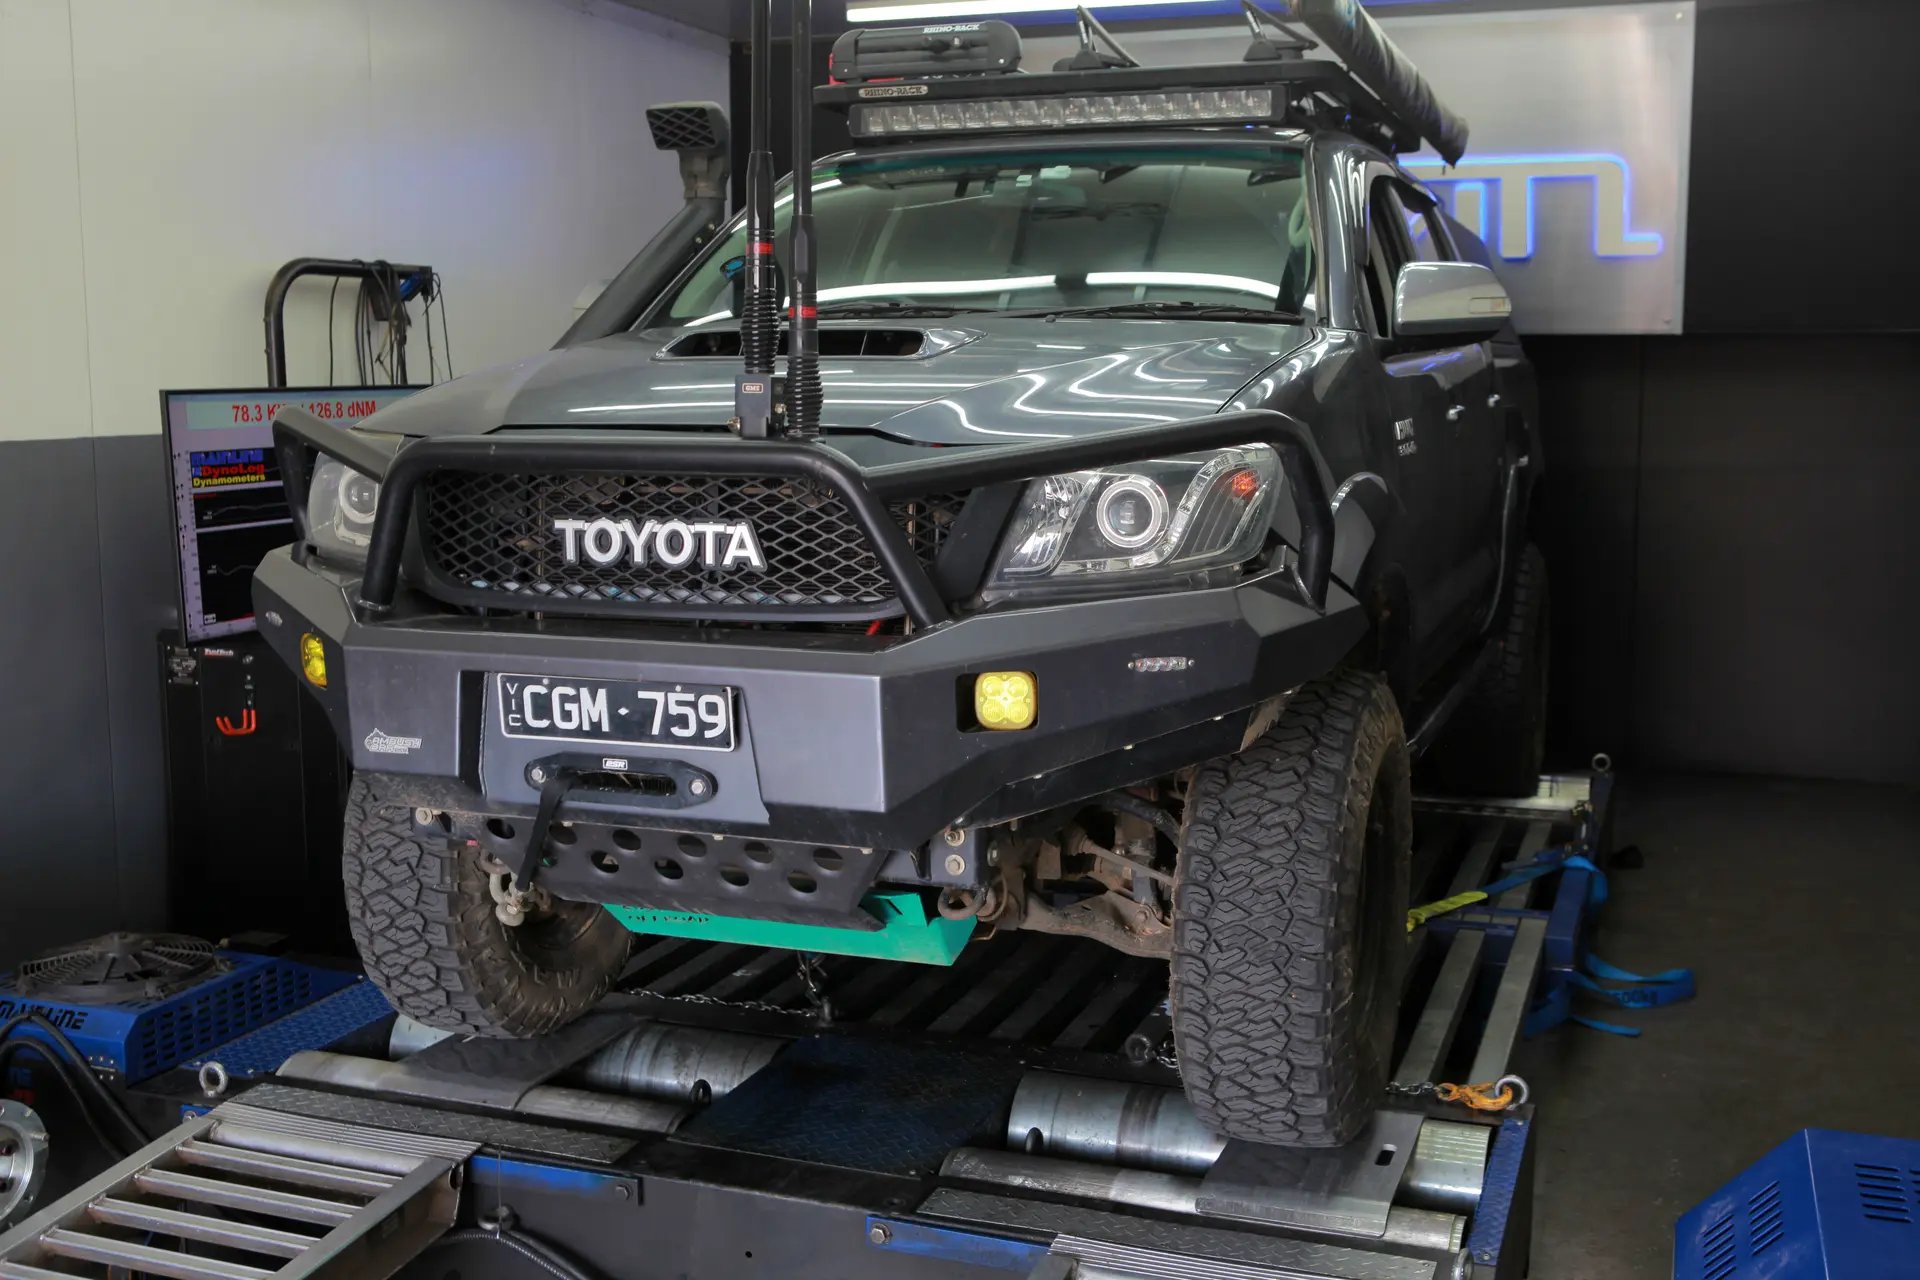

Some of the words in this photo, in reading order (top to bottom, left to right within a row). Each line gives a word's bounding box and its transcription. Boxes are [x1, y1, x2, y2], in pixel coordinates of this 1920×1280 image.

[922, 23, 980, 34] RHINO-RACK
[863, 86, 922, 97] RHINO-RACK
[232, 403, 263, 423] 78.3
[309, 401, 344, 419] 126.8
[348, 400, 376, 418] dNM
[193, 474, 266, 488] Dynamometers
[554, 518, 765, 568] TOYOTA
[506, 683, 522, 727] VIC
[522, 684, 610, 732] CGM
[637, 690, 727, 739] 759
